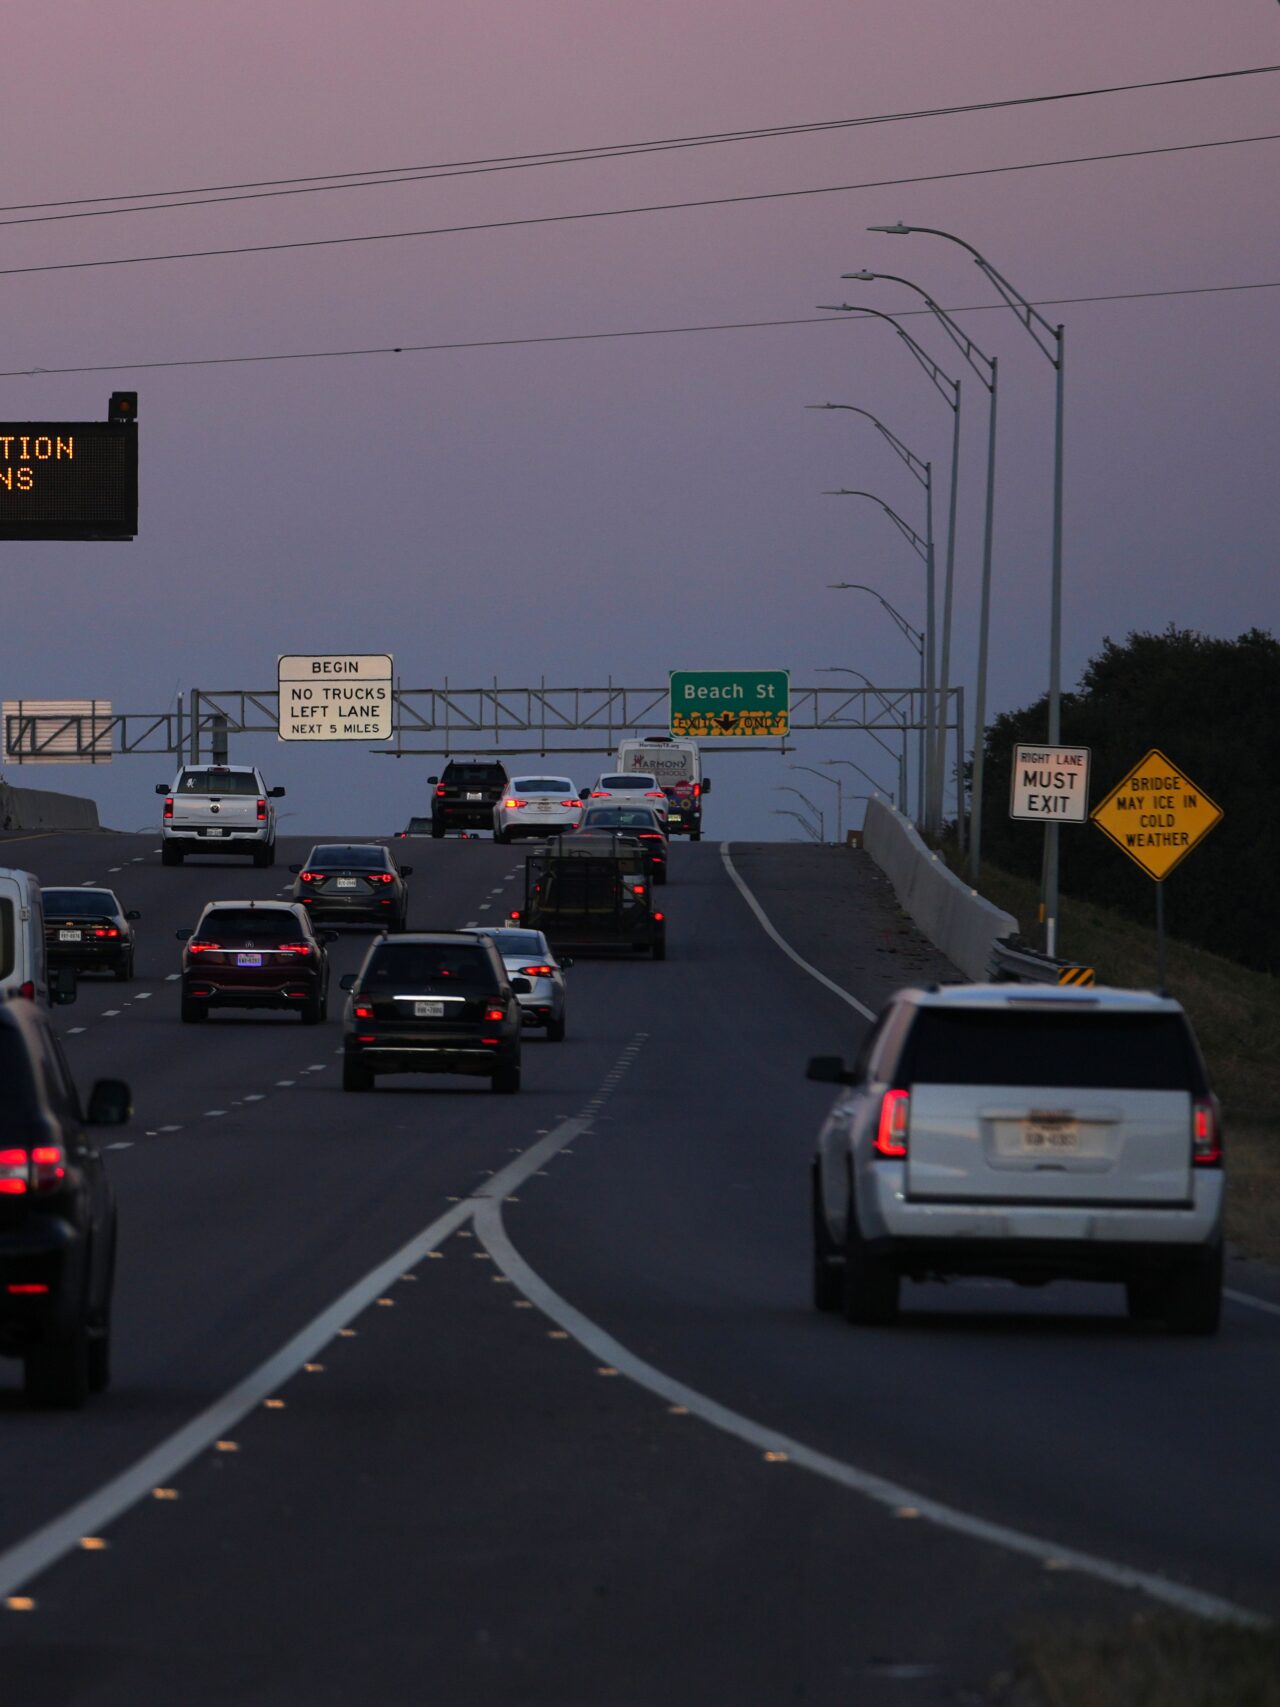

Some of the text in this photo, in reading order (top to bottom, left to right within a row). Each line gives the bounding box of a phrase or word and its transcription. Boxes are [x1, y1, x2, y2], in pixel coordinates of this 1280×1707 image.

[312, 662, 359, 673] BEGIN
[291, 688, 386, 700] NO TRUCKS
[684, 683, 775, 699] Beach St
[291, 705, 380, 718] LEFT LANE
[292, 724, 380, 734] NEXT 5 MILES
[678, 718, 782, 729] EXIT ONLY
[1021, 752, 1083, 766] RIGHT LANE
[1023, 770, 1078, 789] MUST
[1131, 776, 1180, 791] BRIDGE
[1027, 795, 1070, 813] EXIT
[1116, 795, 1197, 811] MAY ICE IN
[1139, 814, 1175, 828] COLD
[1125, 832, 1190, 847] WEATHER
